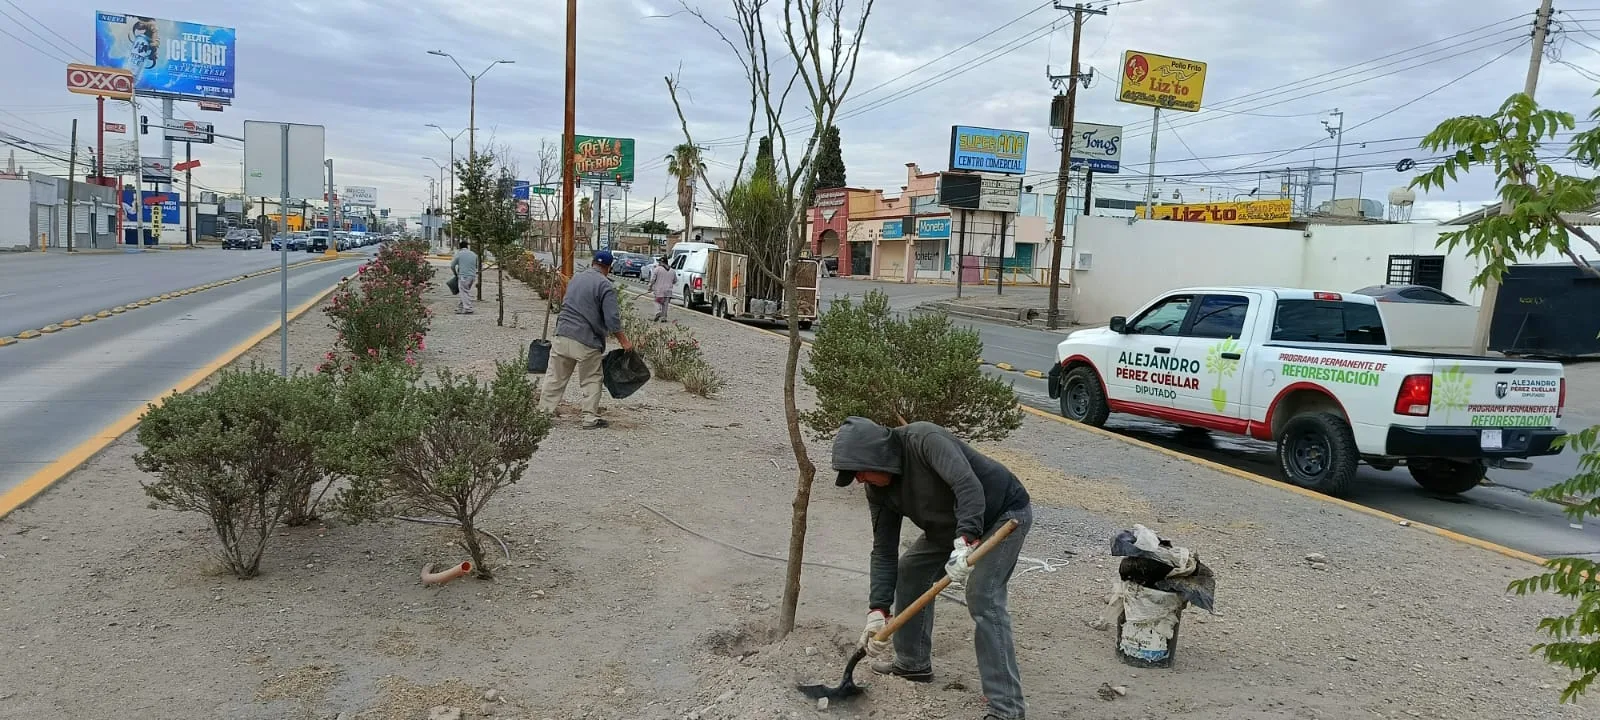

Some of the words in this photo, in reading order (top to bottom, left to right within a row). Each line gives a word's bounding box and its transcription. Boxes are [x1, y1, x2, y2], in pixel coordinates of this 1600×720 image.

[182, 33, 211, 43] TECATE
[166, 39, 187, 62] ICE
[191, 42, 227, 67] LIGHT
[1171, 61, 1187, 70] Pollo
[1187, 63, 1202, 72] Frito
[70, 70, 131, 91] OXXO
[1149, 76, 1190, 96] Liz'to
[959, 133, 996, 150] SUPER
[1082, 129, 1120, 156] Tonos
[959, 156, 984, 168] CENTRO
[985, 158, 1022, 170] COMERCIAL
[1172, 205, 1237, 221] Liz'to
[920, 221, 945, 232] Moneta
[1118, 351, 1200, 374] ALEJANDRO
[1279, 353, 1318, 365] PROGRAMA
[1320, 356, 1377, 371] PERMANENTE
[1378, 362, 1388, 372] DE
[1116, 364, 1148, 383] PÉREZ
[1150, 370, 1200, 390] CUÉLLAR
[1281, 364, 1380, 387] REFORESTACIÓN
[1511, 379, 1557, 387] ALEJANDRO
[1135, 384, 1177, 400] DIPUTADO
[1467, 404, 1505, 413] PROGRAMA
[1506, 404, 1548, 413] PERMANENTE
[1548, 405, 1557, 413] DE
[1471, 414, 1552, 427] REFORESTACIÓN
